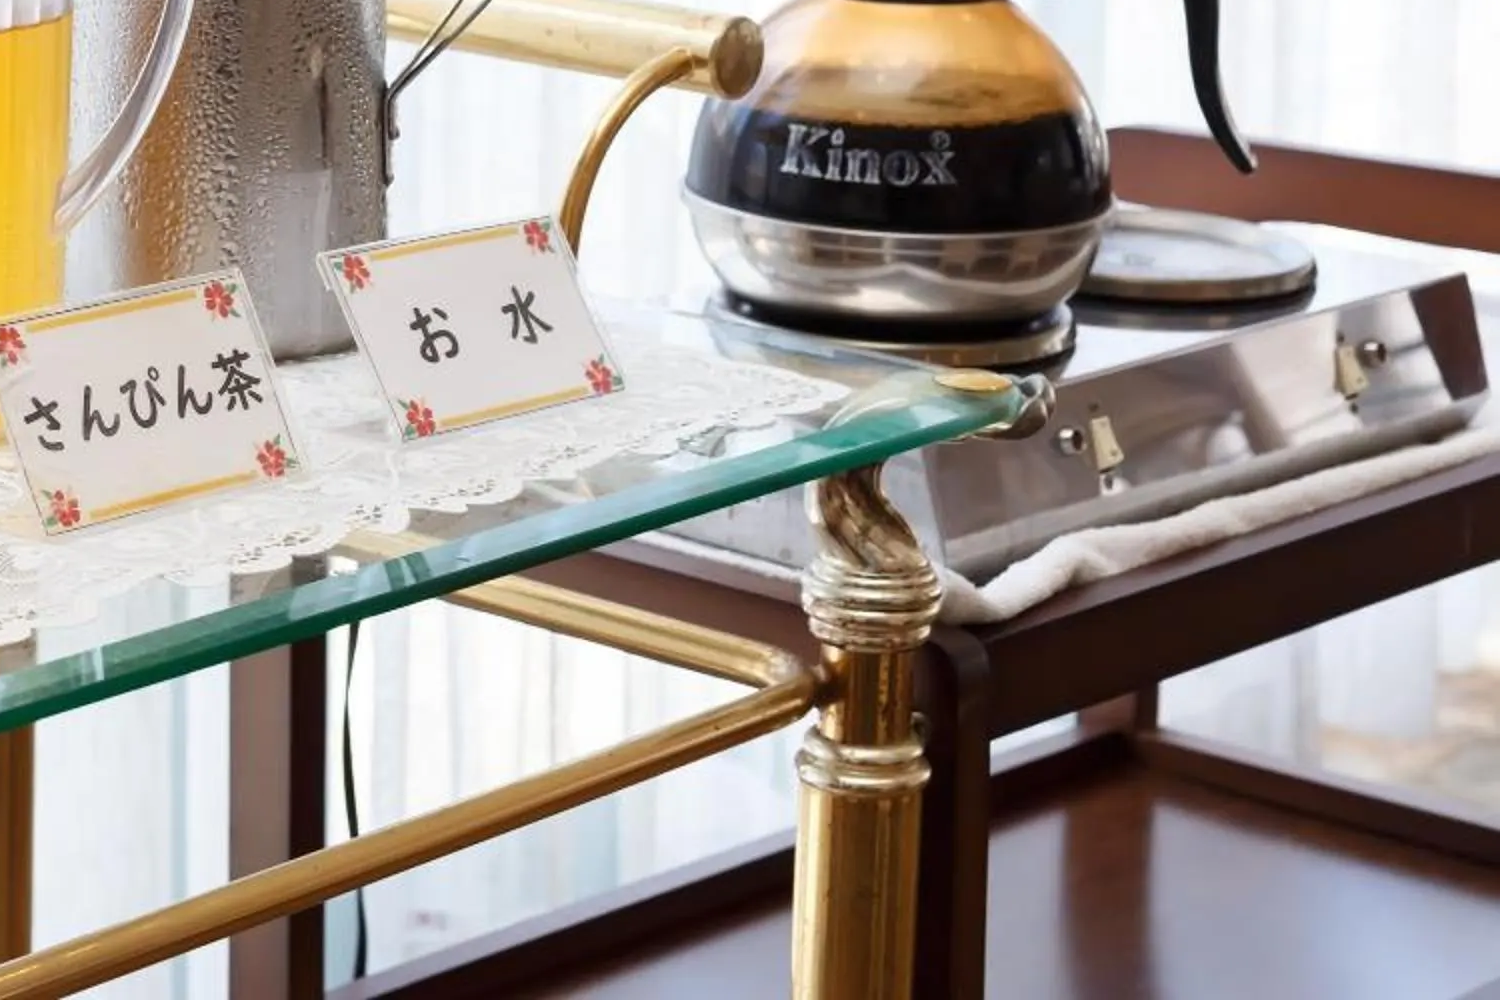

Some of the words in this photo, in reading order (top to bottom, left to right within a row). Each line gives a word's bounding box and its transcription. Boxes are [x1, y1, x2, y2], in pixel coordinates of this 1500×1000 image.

[23, 349, 264, 452] さんぴん茶
